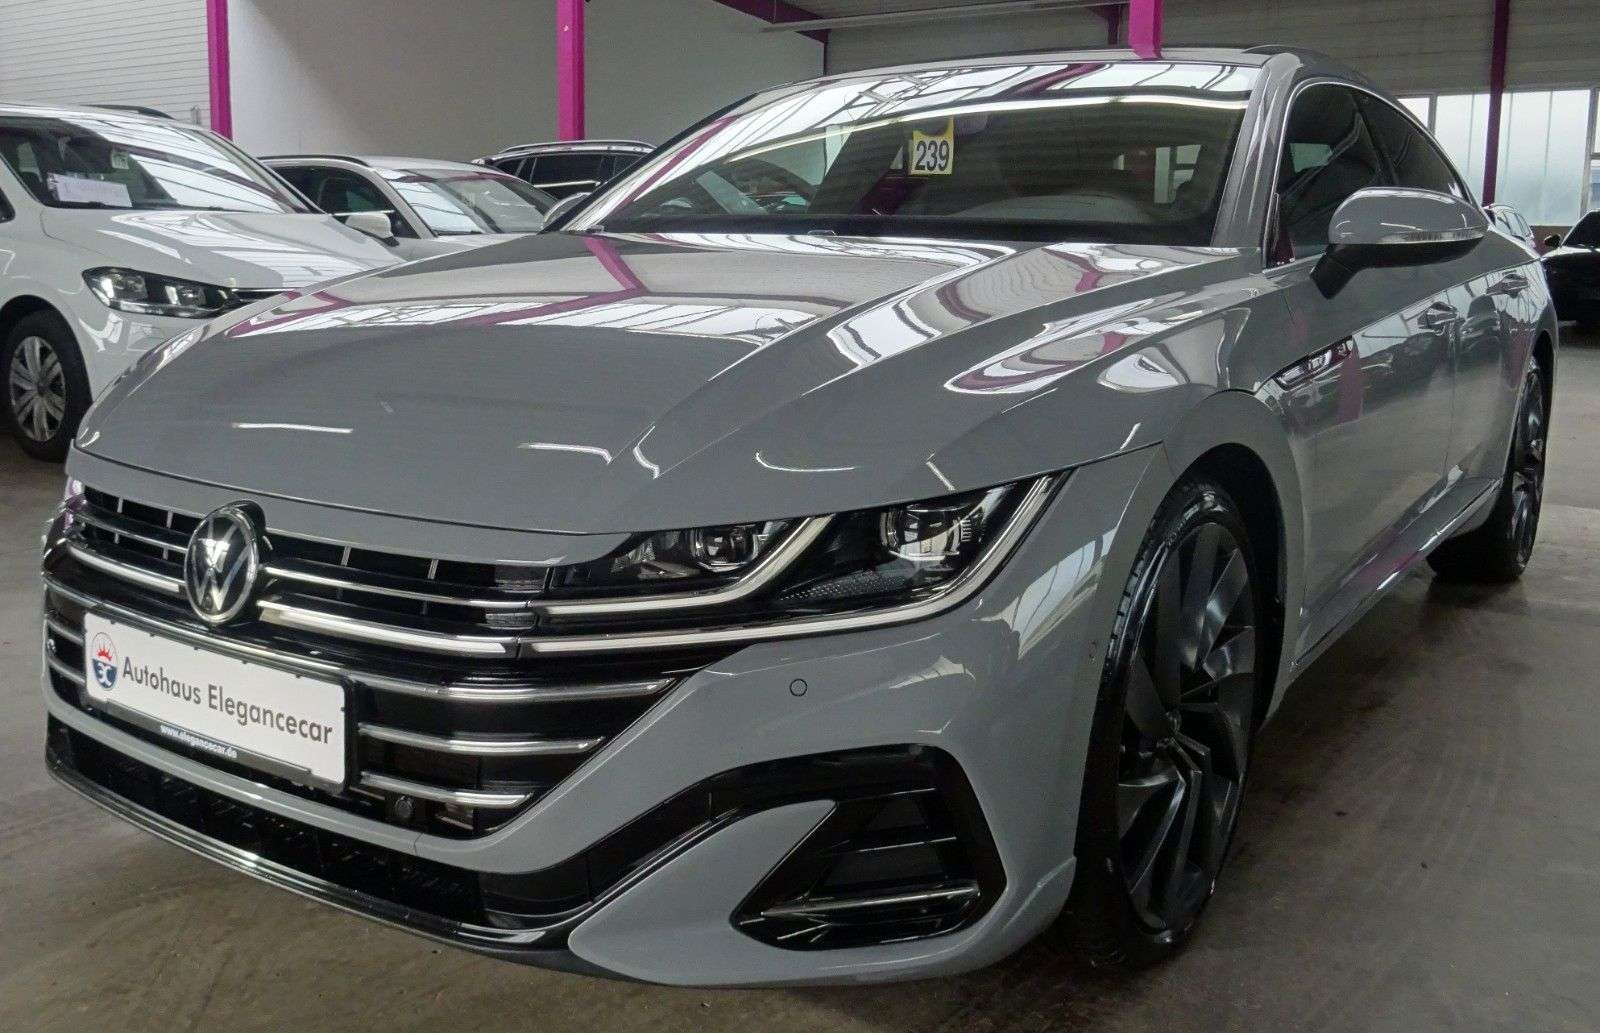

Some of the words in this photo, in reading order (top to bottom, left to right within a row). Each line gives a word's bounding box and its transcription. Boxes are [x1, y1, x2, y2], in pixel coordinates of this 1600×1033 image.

[914, 140, 950, 171] 239
[122, 656, 201, 704] Autohaus
[208, 684, 333, 744] Elegancecar
